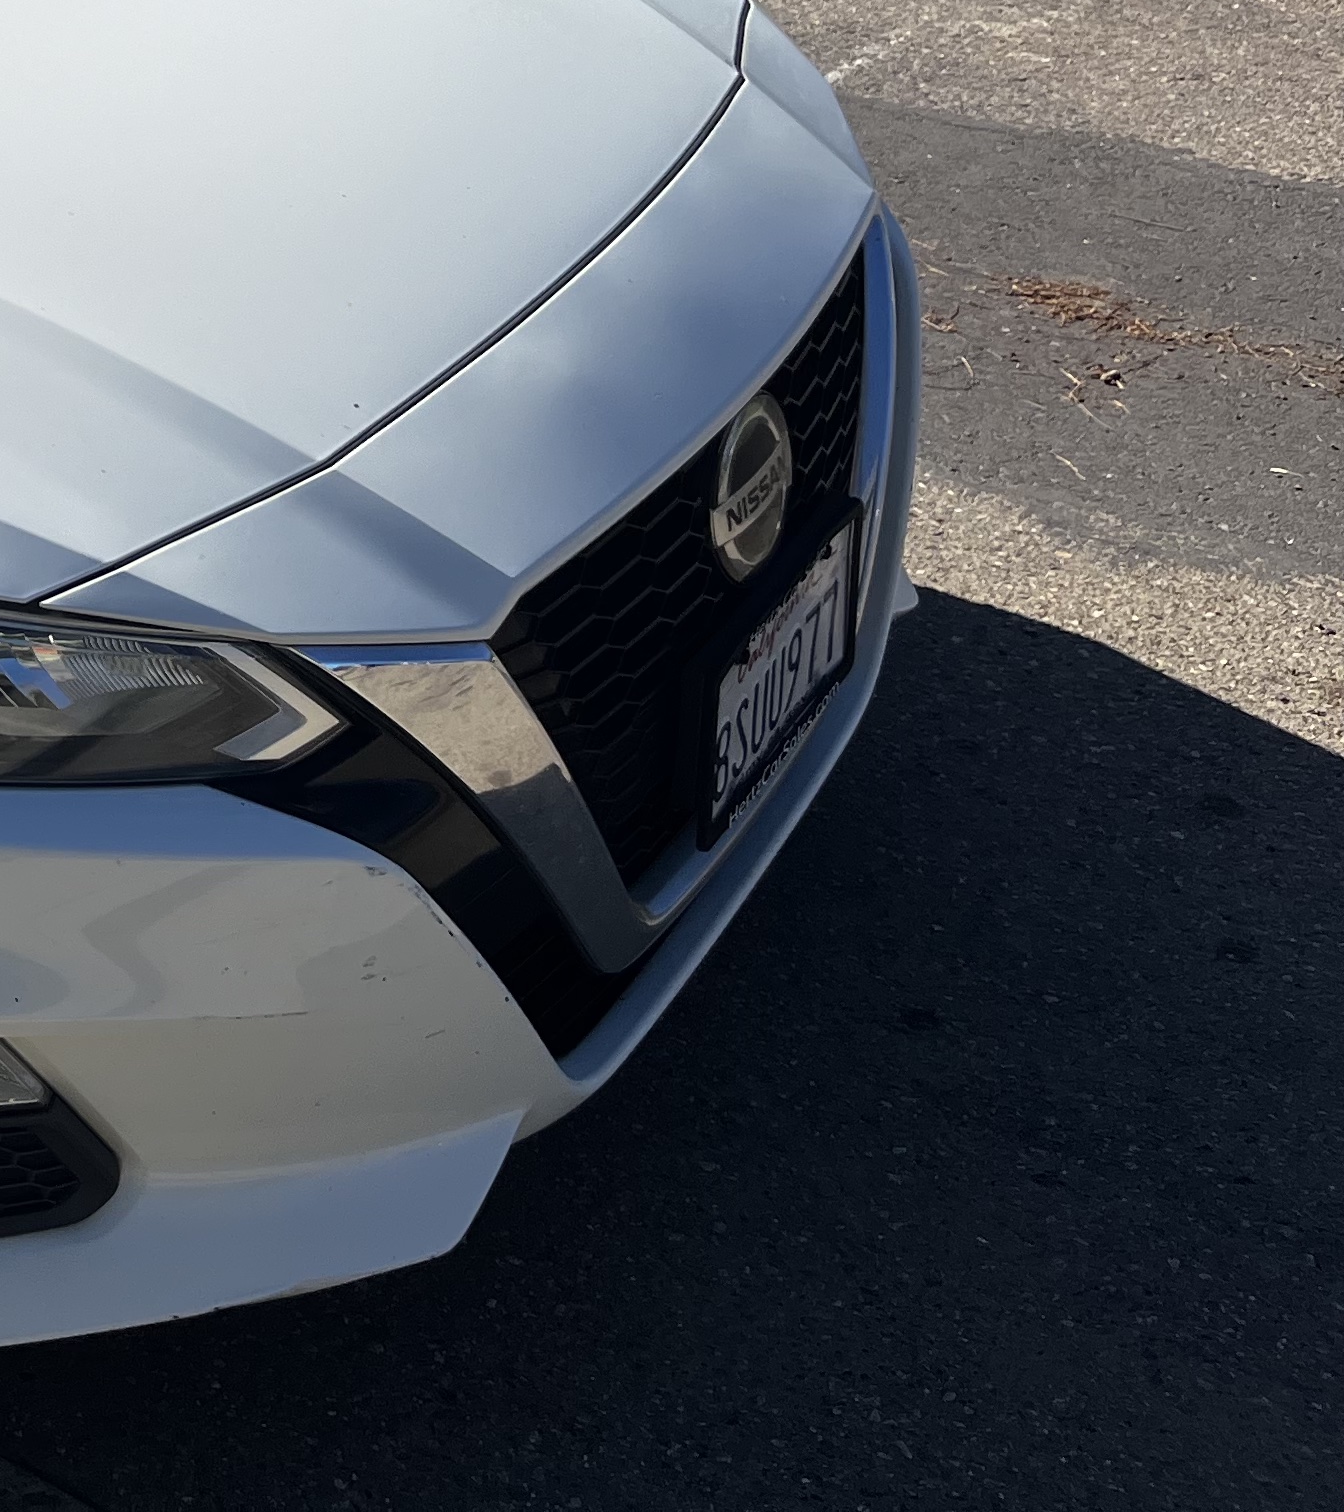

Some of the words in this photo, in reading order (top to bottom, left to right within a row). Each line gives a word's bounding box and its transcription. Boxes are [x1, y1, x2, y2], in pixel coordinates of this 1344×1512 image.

[725, 455, 788, 532] NISSAN
[712, 577, 839, 806] 8SUU977
[728, 680, 840, 829] HertzCarSales.com
